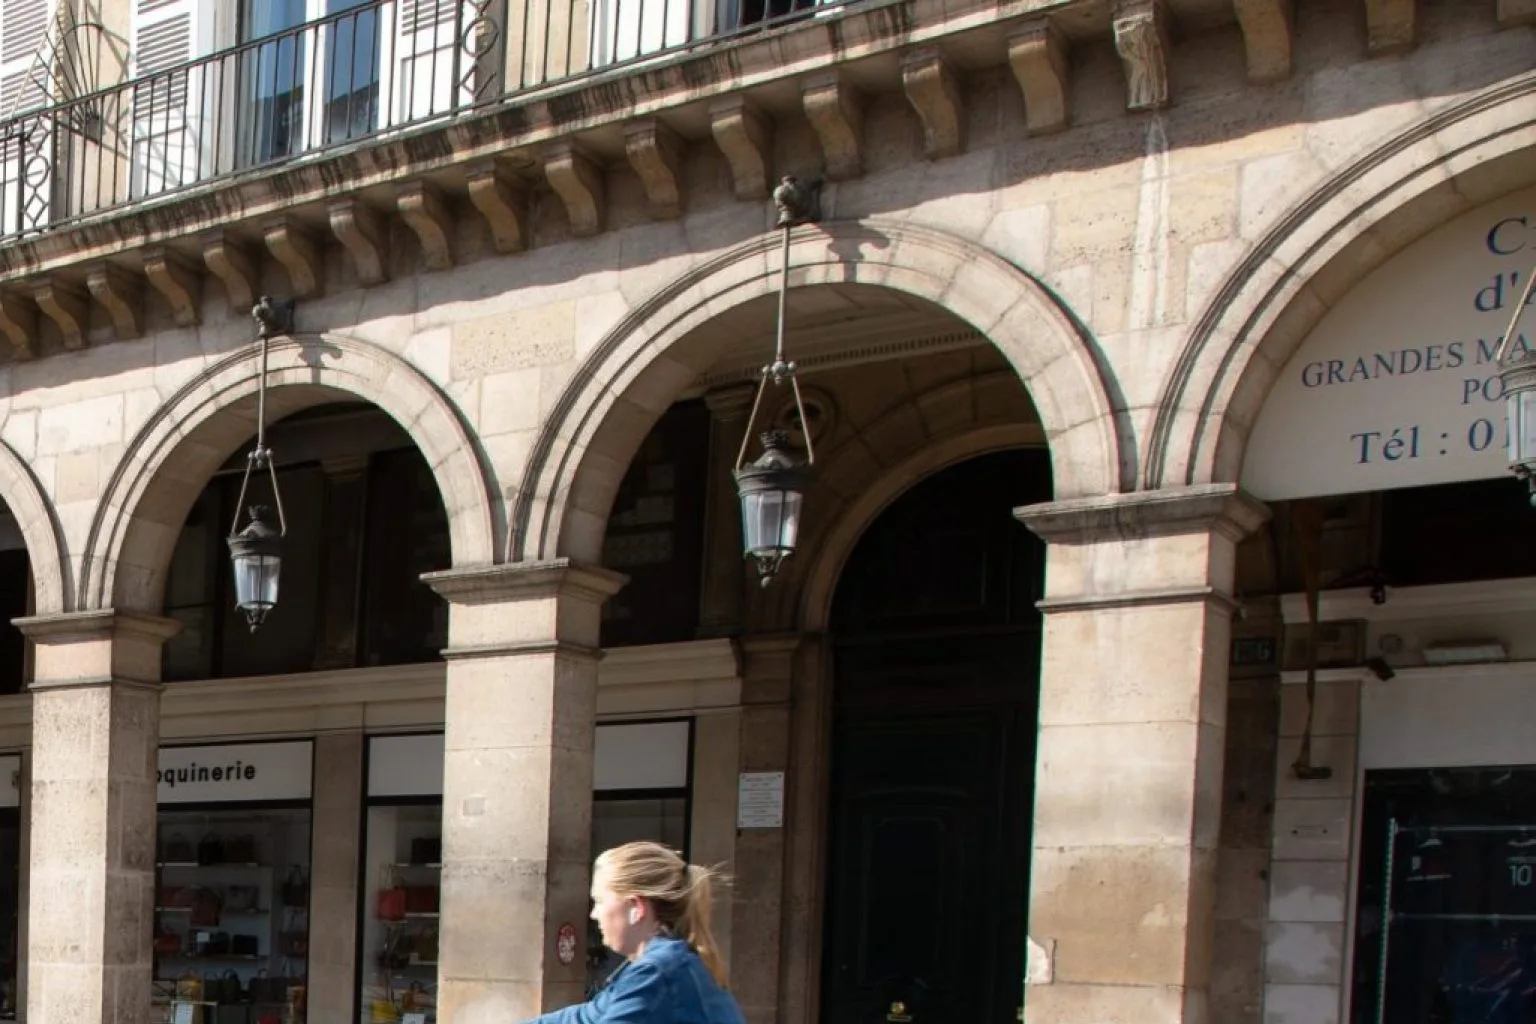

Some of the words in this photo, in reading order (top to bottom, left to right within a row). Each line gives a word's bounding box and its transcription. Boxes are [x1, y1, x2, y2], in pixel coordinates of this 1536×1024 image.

[1487, 216, 1536, 256] C
[1301, 341, 1465, 388] GRANDES
[1350, 424, 1420, 465] Tél
